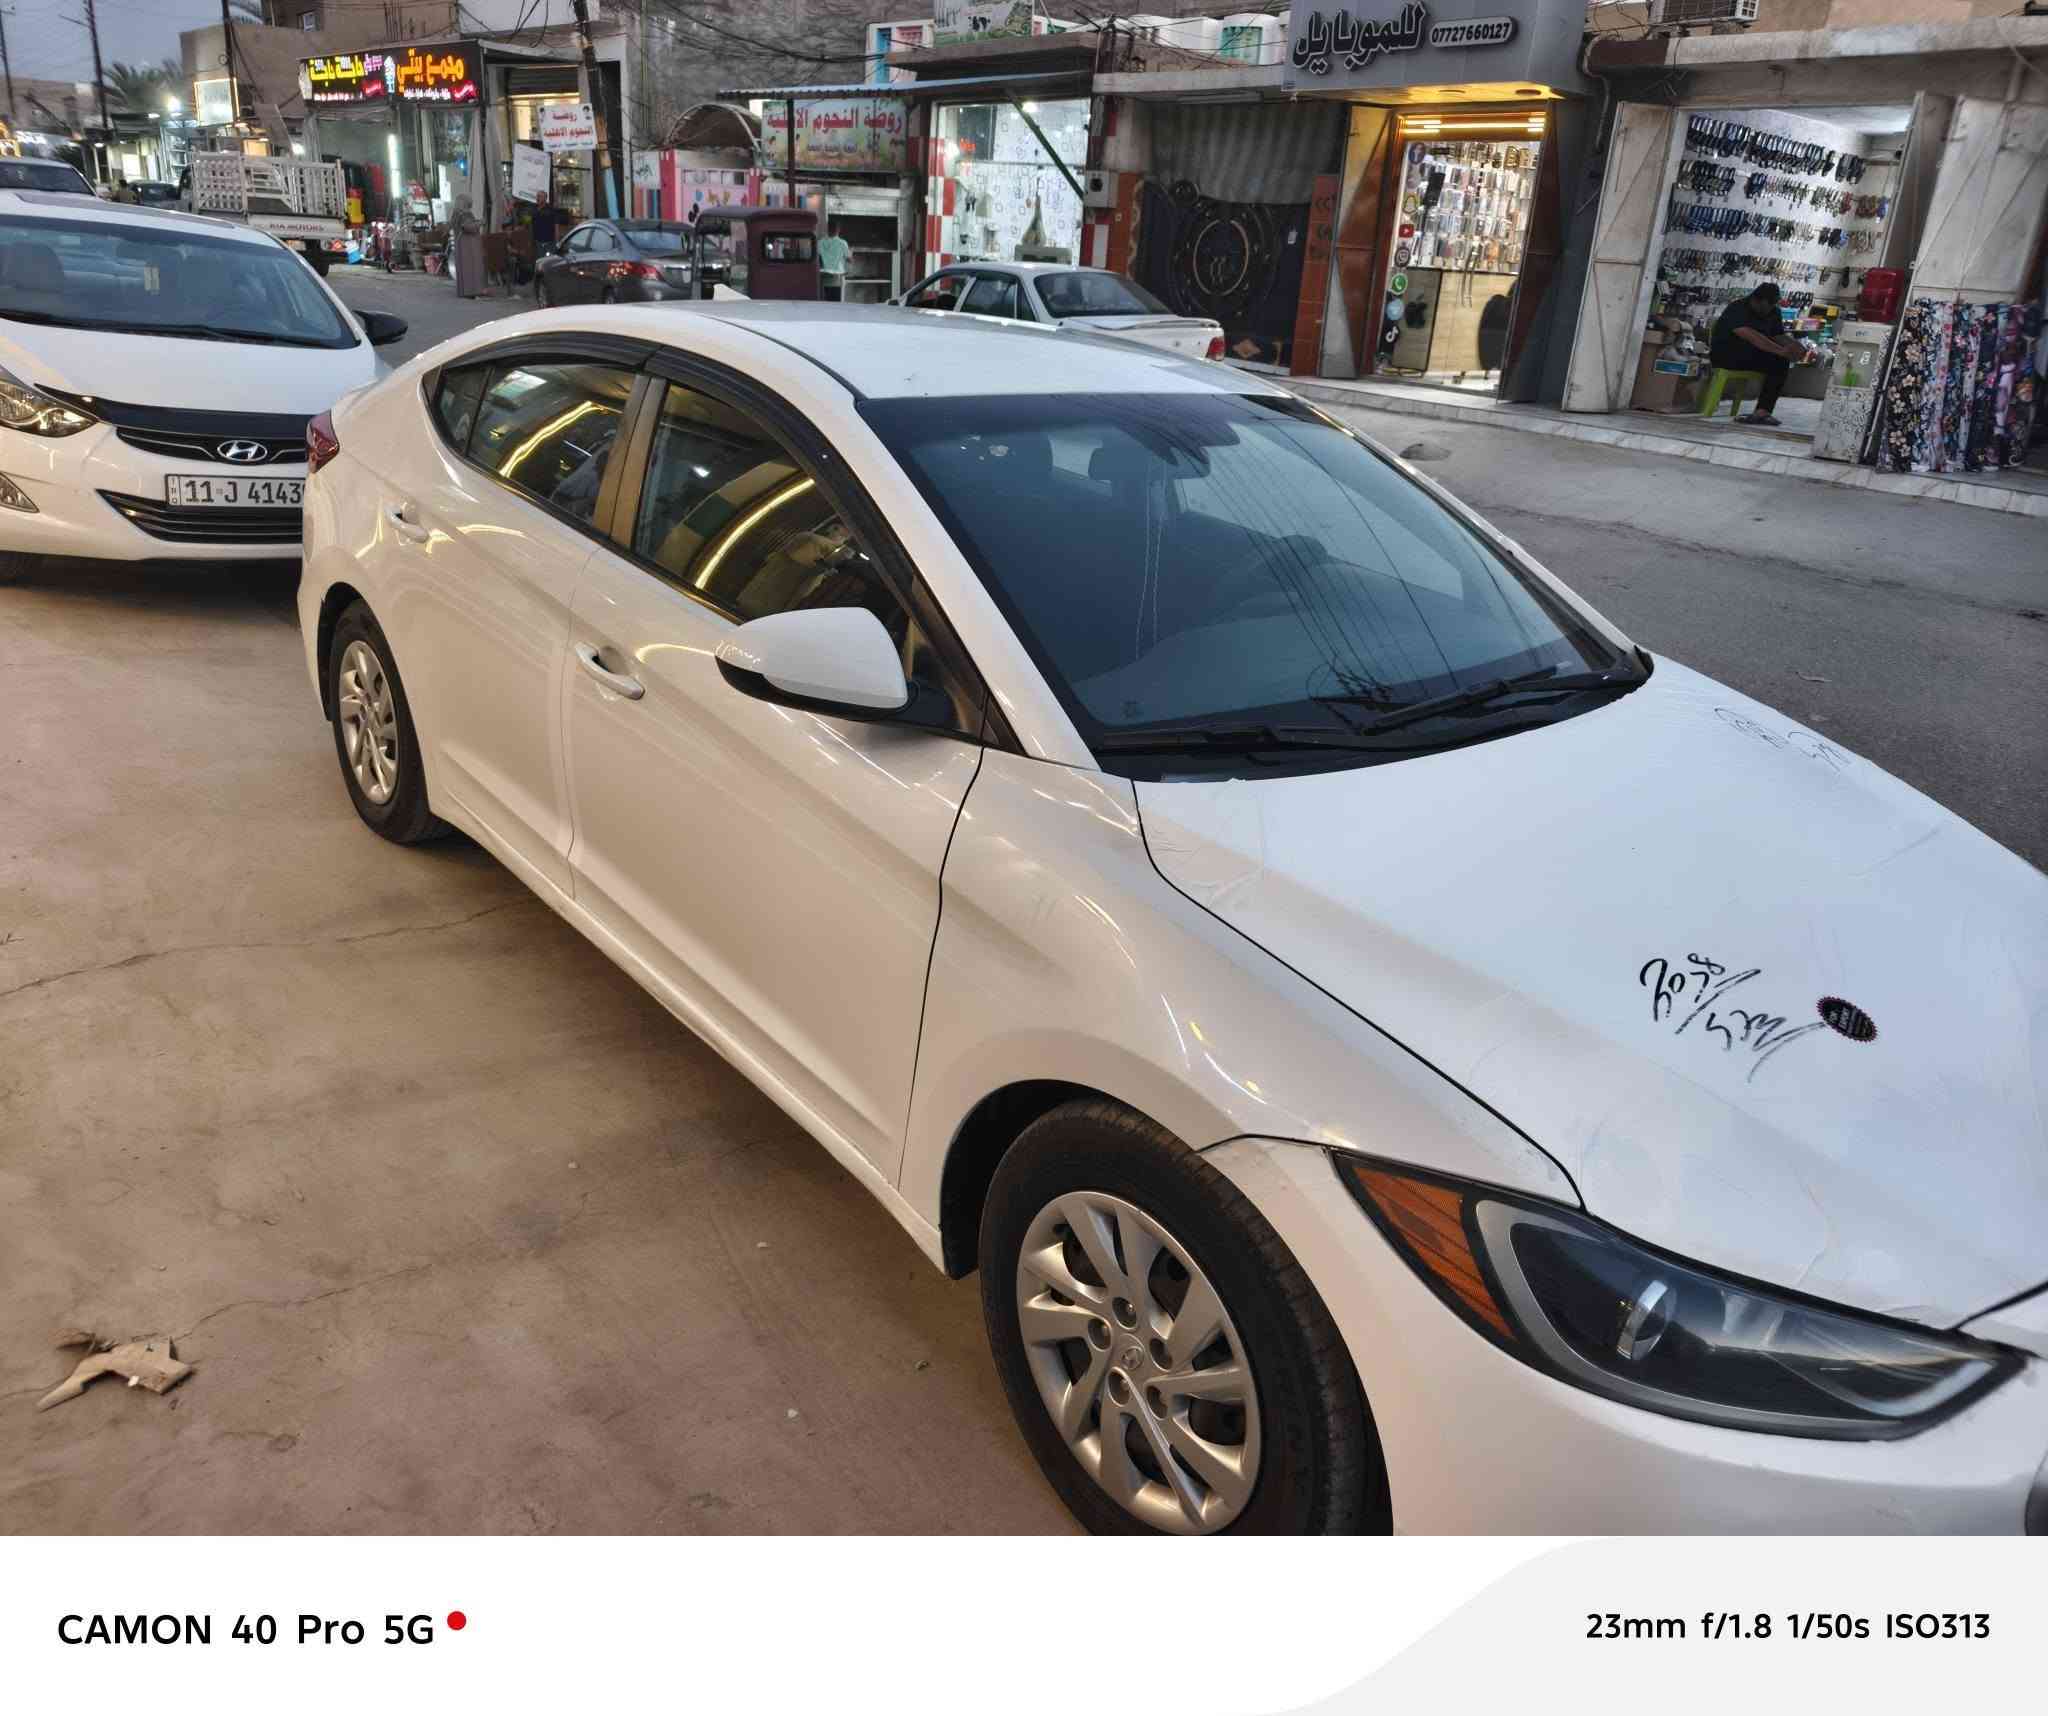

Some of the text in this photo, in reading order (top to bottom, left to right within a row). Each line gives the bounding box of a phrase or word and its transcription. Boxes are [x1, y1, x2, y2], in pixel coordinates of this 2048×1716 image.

[1294, 1, 1426, 75] للموبايل
[1431, 23, 1510, 44] 07727660127
[426, 54, 465, 85] مجمع
[813, 106, 859, 134] النجوم
[864, 105, 902, 134] روضة
[186, 480, 304, 504] 11 J 4143
